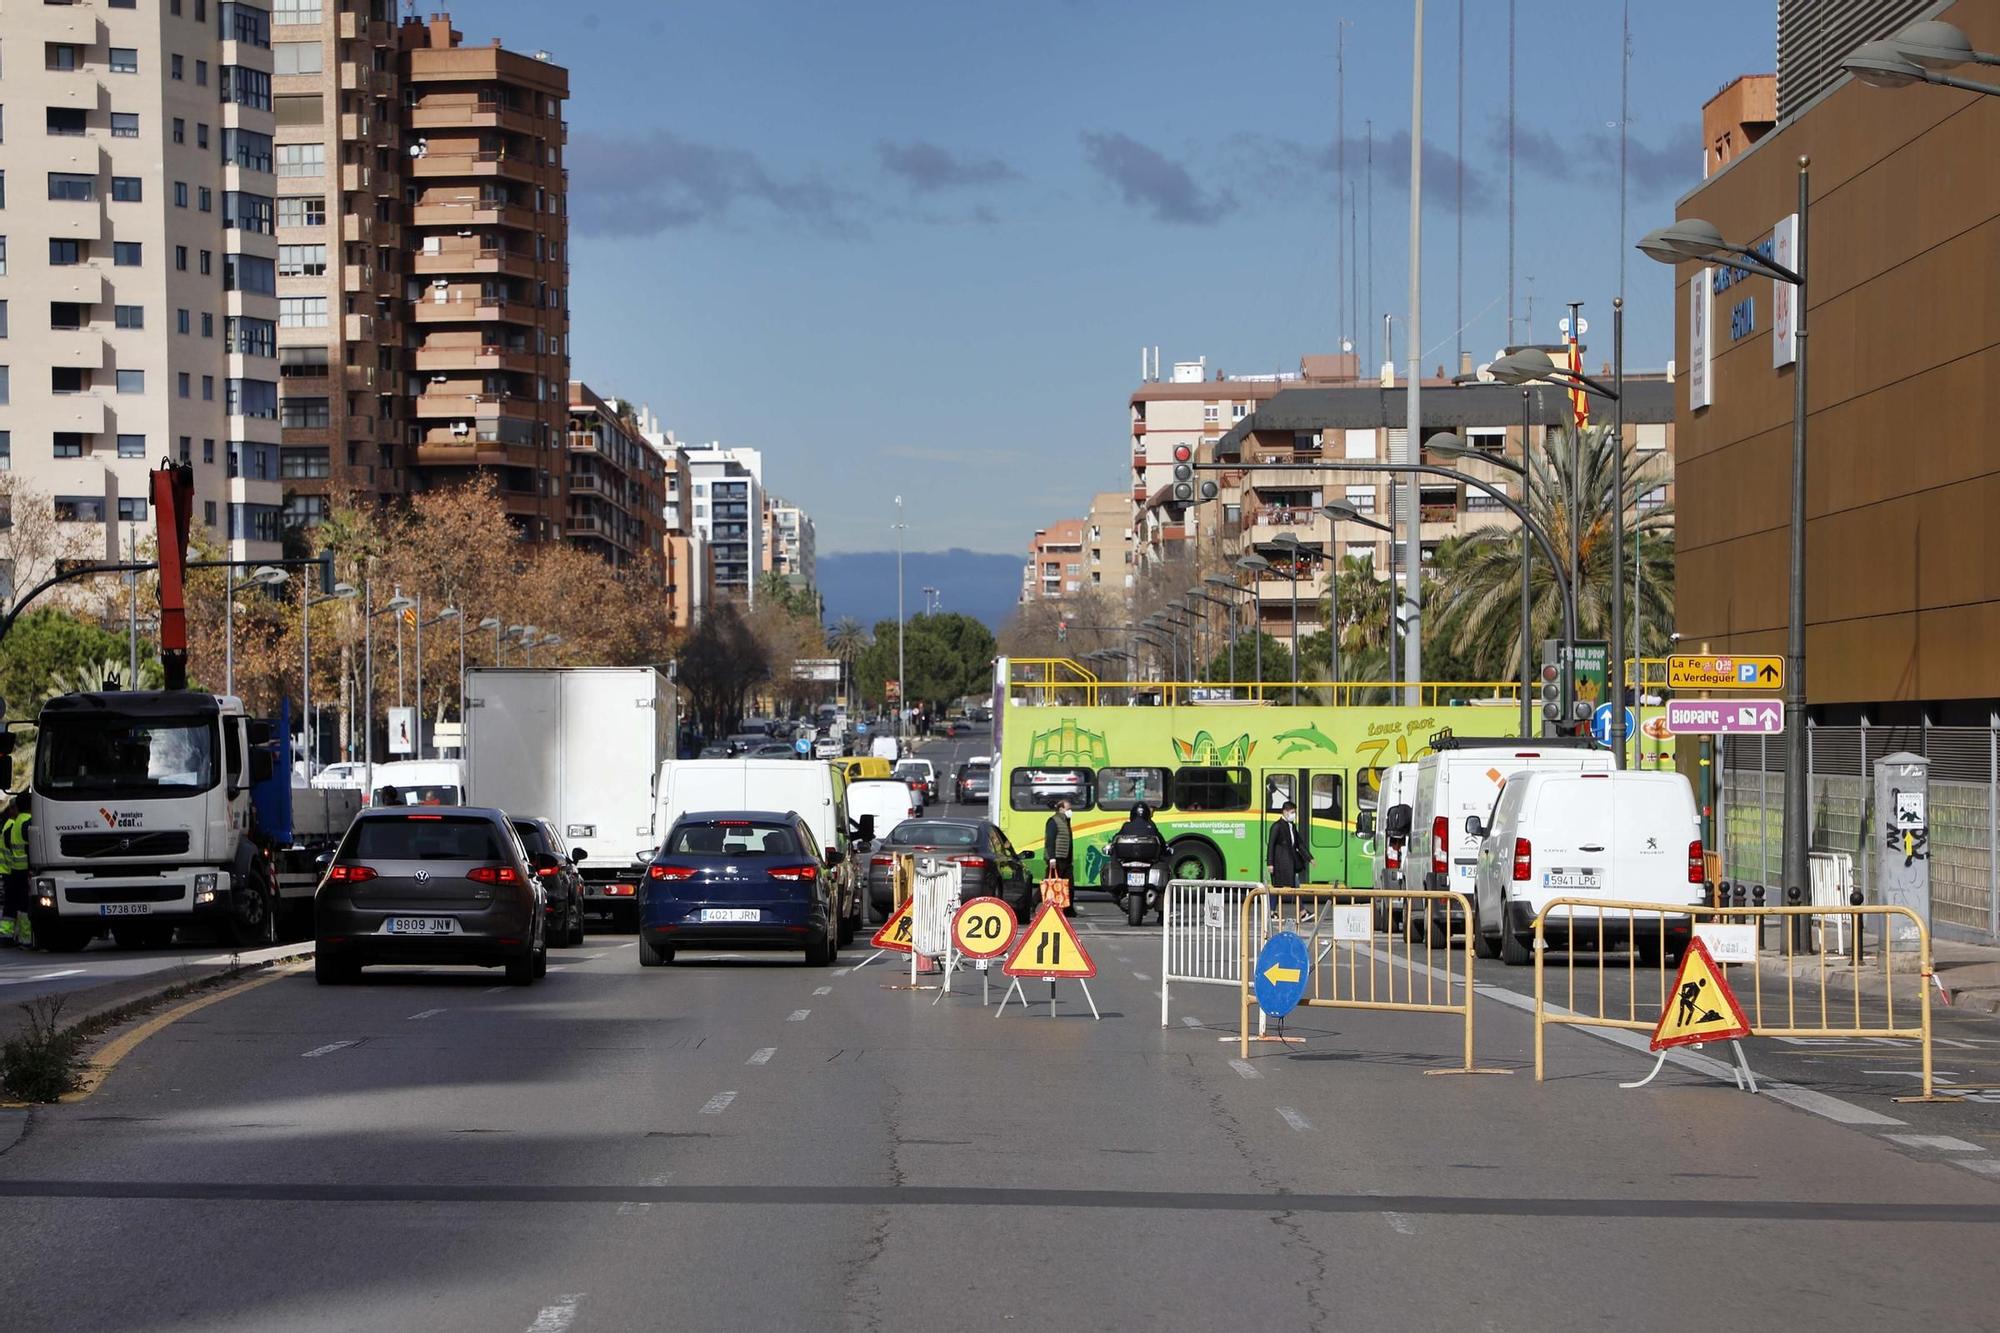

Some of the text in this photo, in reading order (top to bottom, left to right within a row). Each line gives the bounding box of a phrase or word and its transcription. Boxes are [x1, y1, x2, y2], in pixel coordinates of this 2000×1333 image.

[1672, 660, 1701, 668] La Fe
[1551, 875, 1596, 886] 5941 LPG
[106, 904, 148, 914] 5738 GXB
[709, 910, 757, 920] 4021 JRN
[396, 919, 452, 930] 9809 JNW
[965, 915, 1002, 939] 20
